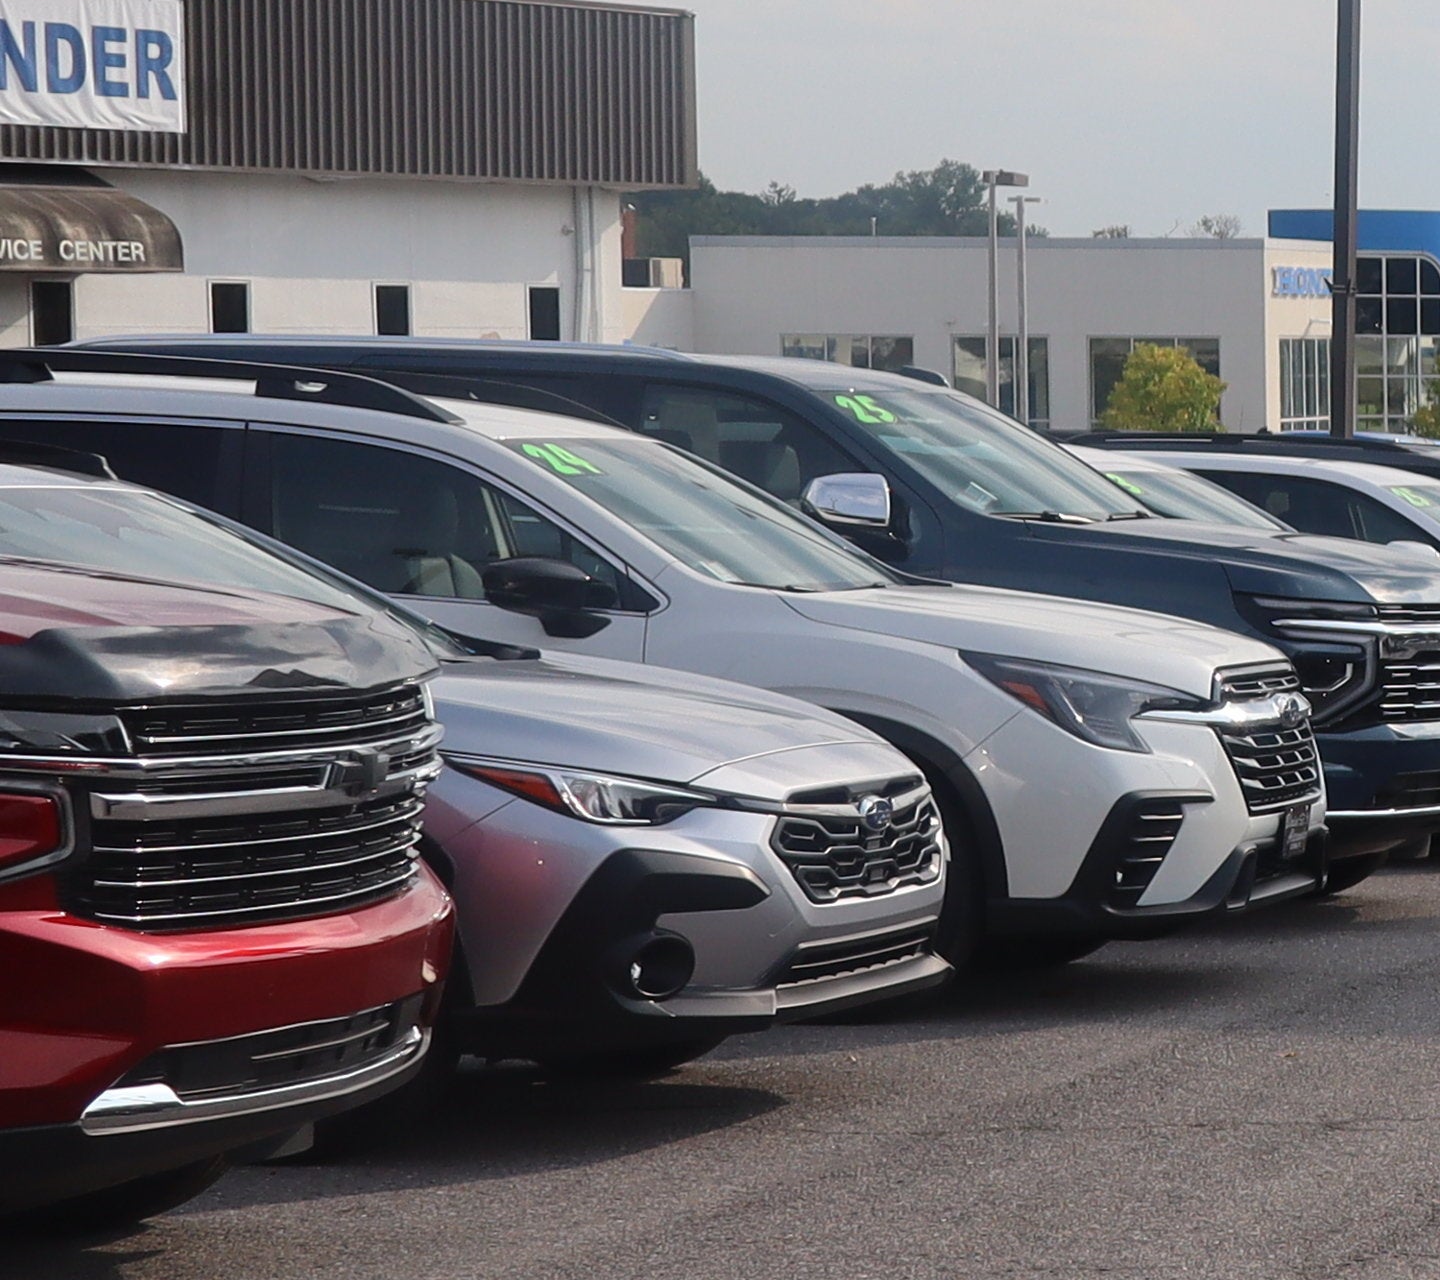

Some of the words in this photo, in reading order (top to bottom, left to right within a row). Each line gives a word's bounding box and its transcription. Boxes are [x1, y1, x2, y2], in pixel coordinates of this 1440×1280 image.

[59, 240, 146, 262] CENTER
[834, 394, 898, 424] 25
[521, 442, 605, 476] 24
